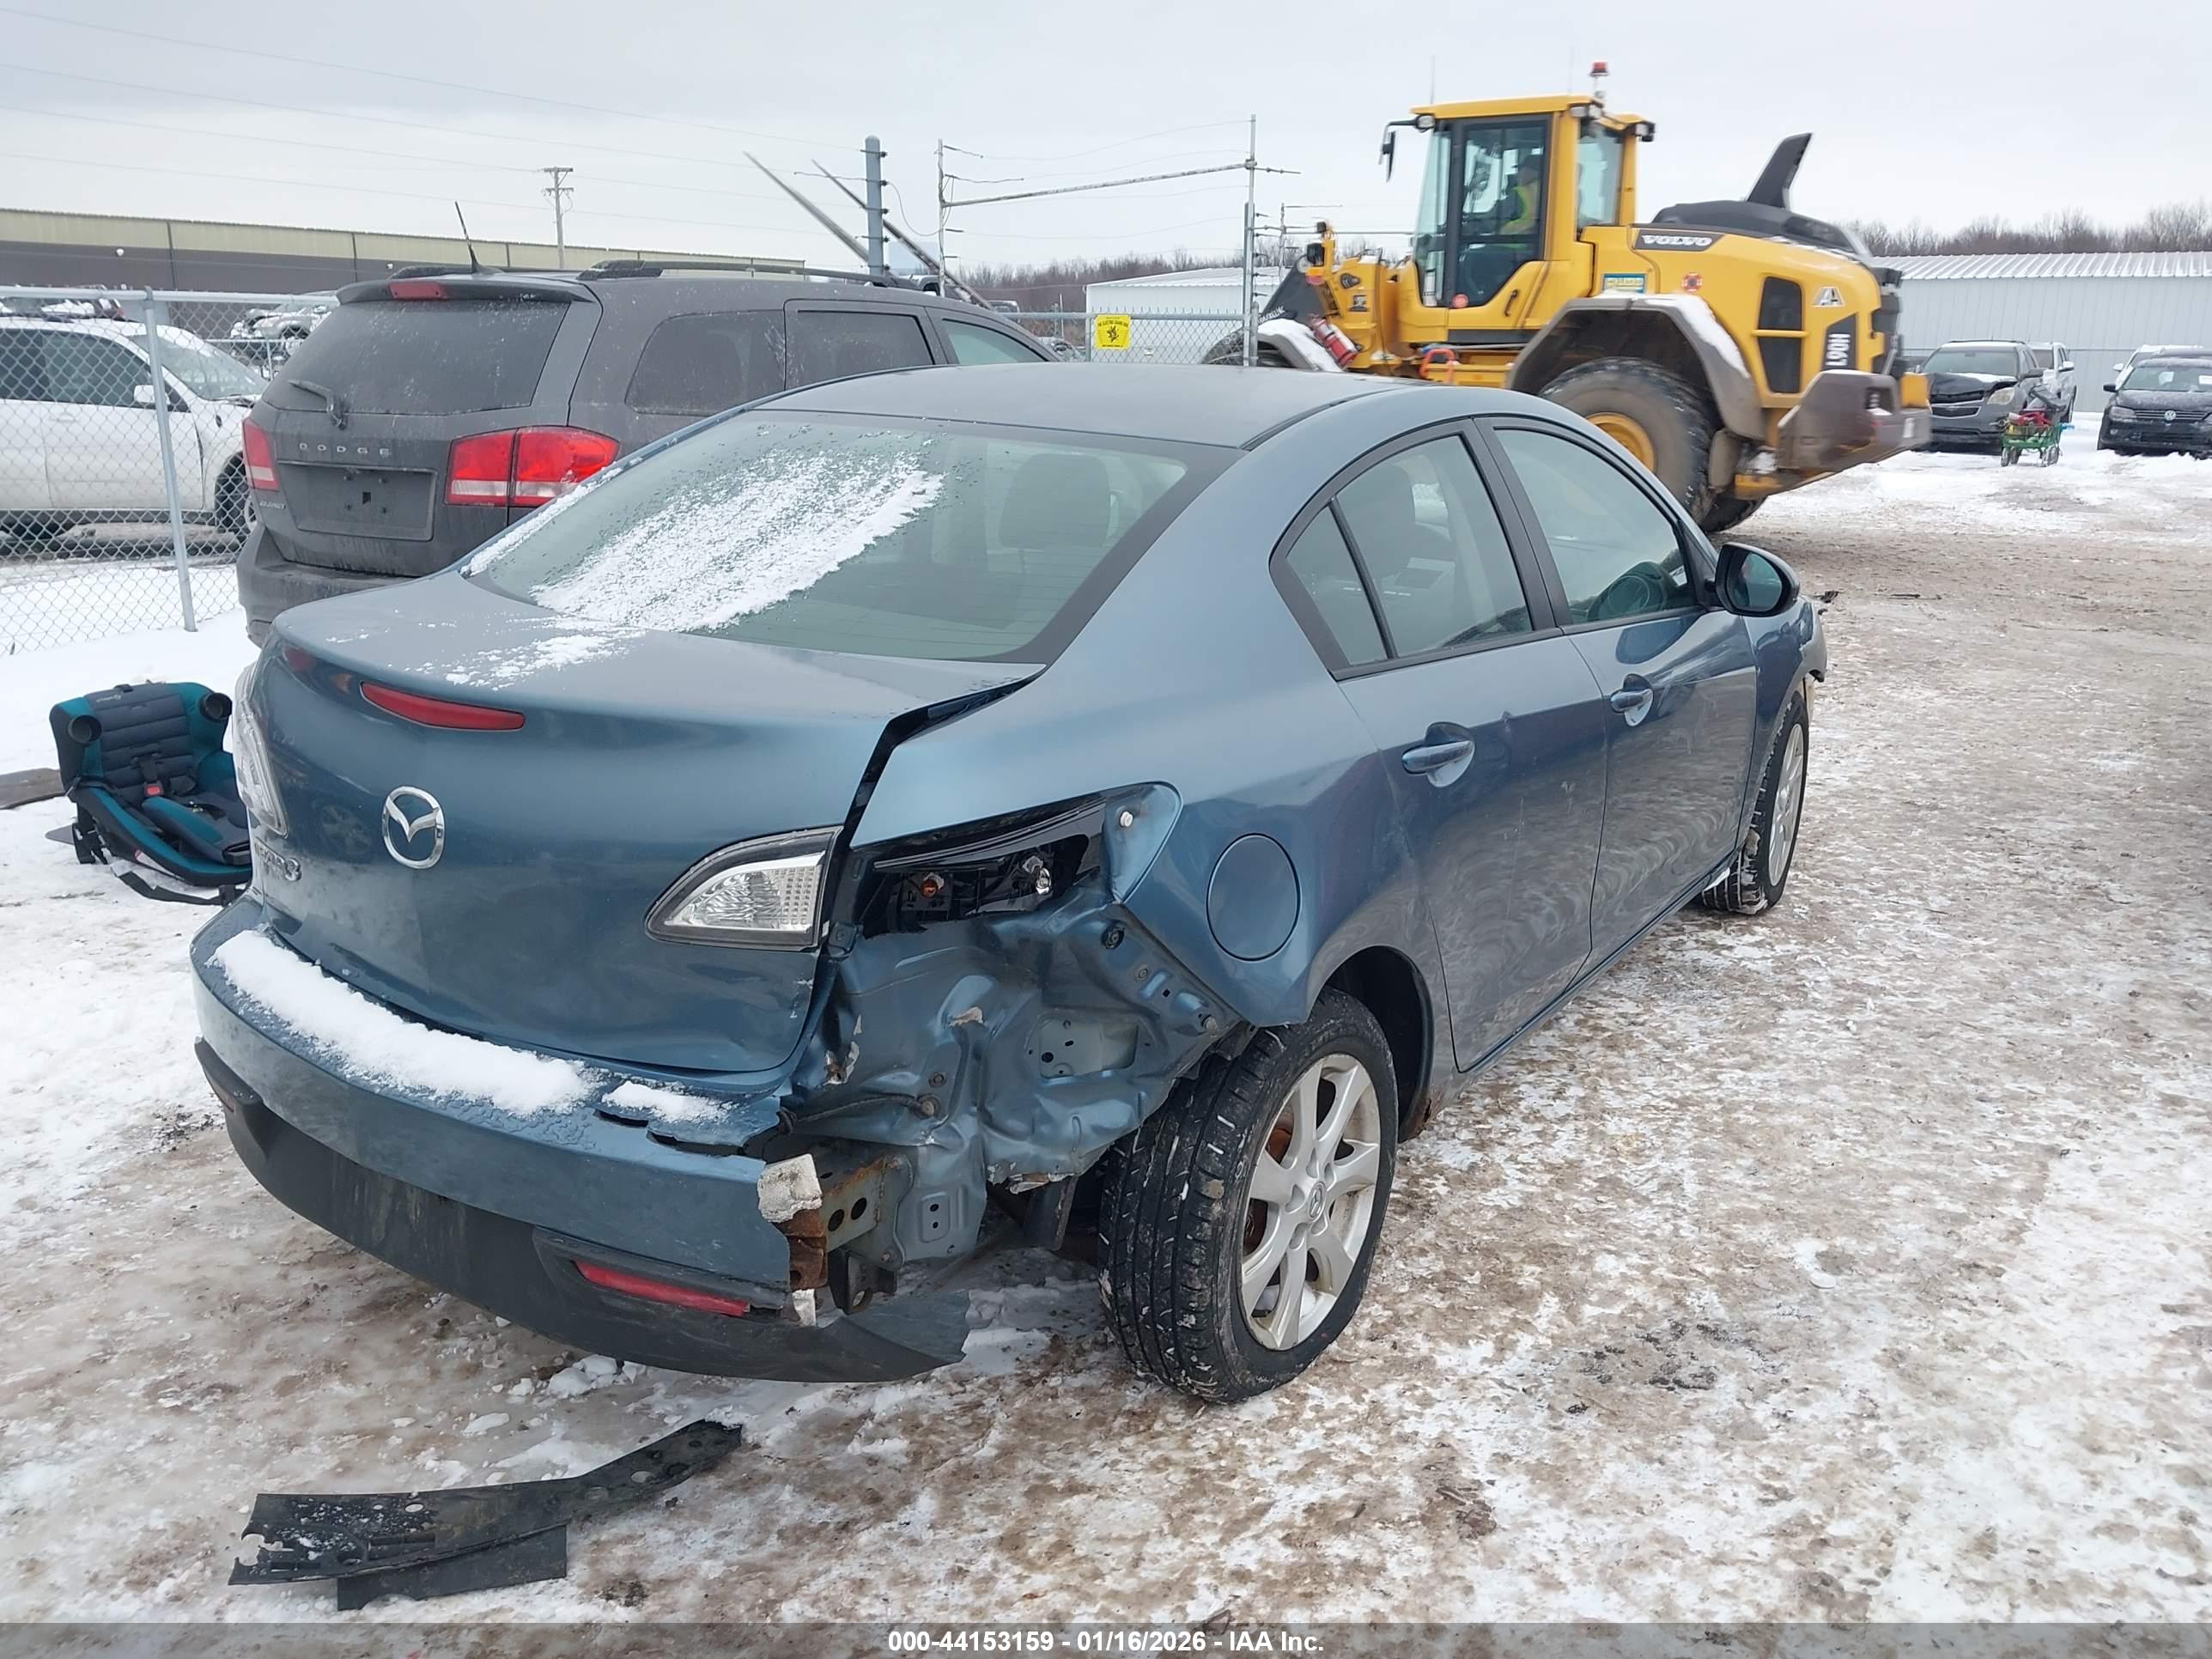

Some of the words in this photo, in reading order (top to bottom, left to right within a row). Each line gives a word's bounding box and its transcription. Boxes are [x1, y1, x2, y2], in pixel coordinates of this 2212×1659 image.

[1641, 234, 1712, 246] VOLVO
[1825, 333, 1851, 367] L90H
[299, 442, 392, 456] DODGE
